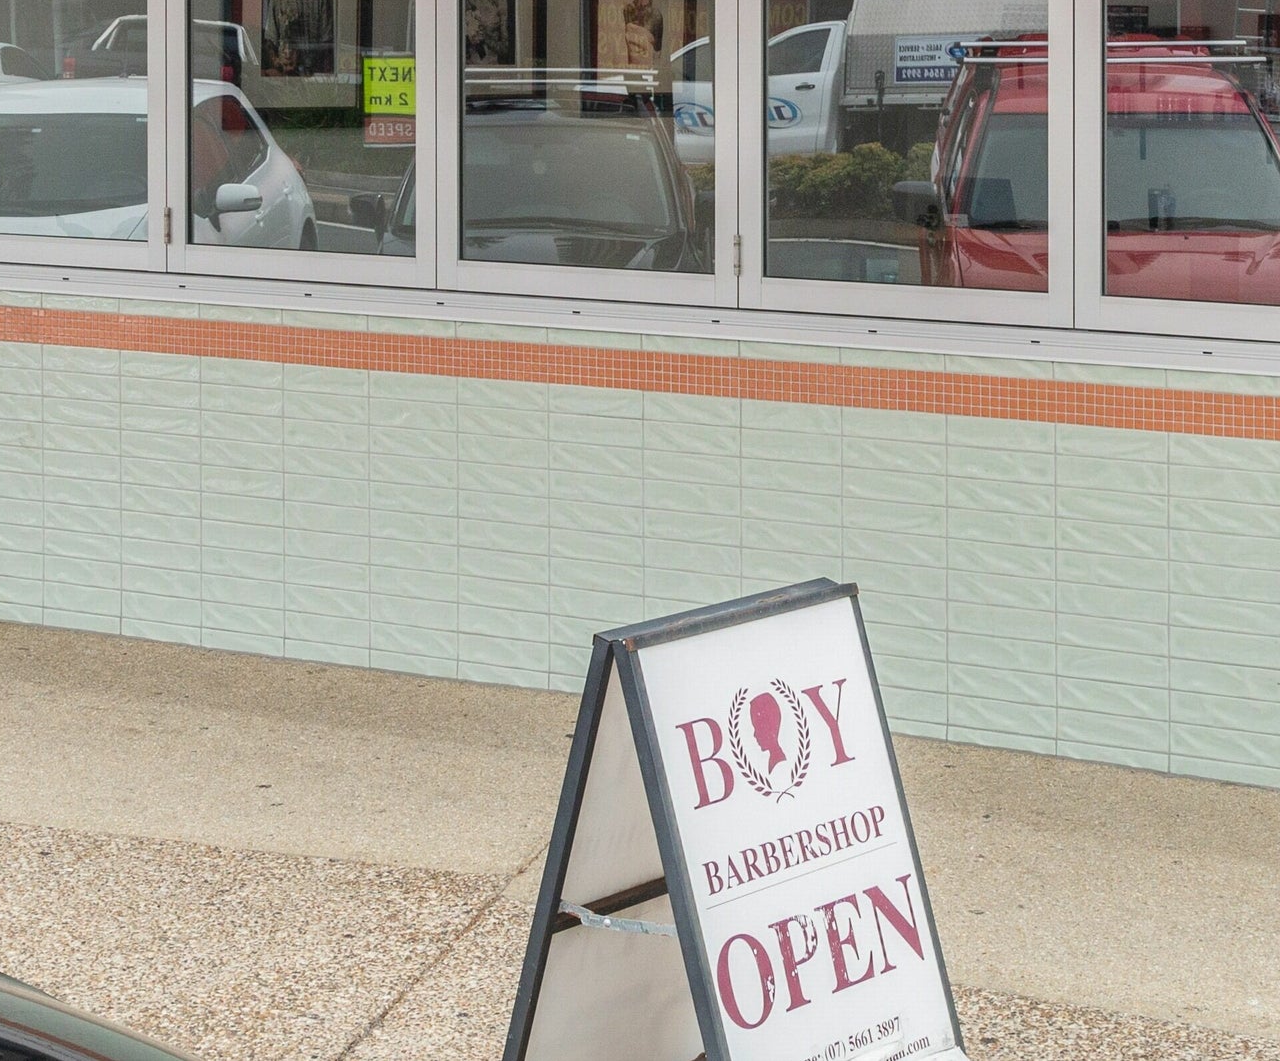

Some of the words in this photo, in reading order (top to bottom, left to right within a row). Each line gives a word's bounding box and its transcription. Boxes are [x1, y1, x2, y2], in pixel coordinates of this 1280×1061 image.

[702, 804, 887, 897] BARBERSHOP
[715, 873, 926, 1030] OPEN
[848, 1028, 874, 1052] 5661
[876, 1016, 902, 1041] 3897
